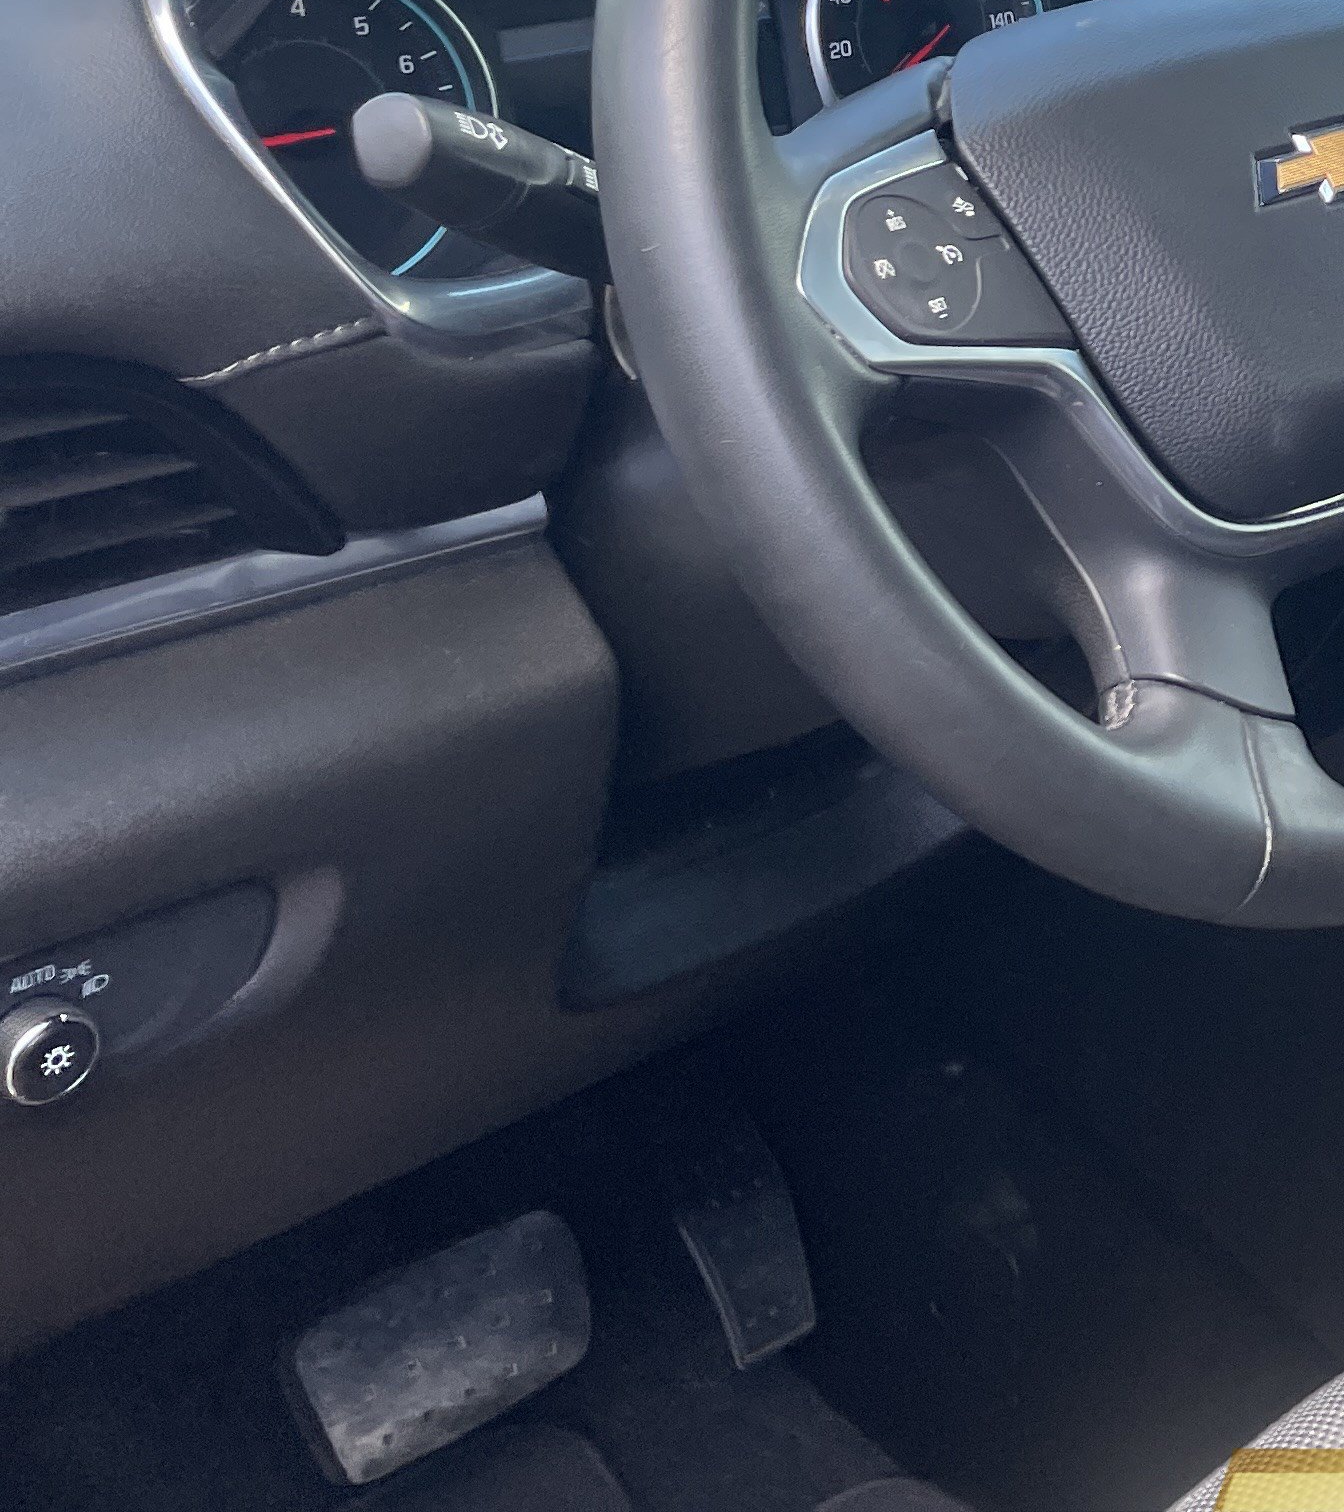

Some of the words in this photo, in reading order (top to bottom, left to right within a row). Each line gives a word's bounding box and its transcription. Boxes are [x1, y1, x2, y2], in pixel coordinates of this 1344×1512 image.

[353, 15, 370, 36] 5
[988, 10, 1016, 30] 140
[828, 39, 852, 60] 20
[399, 54, 415, 74] 6
